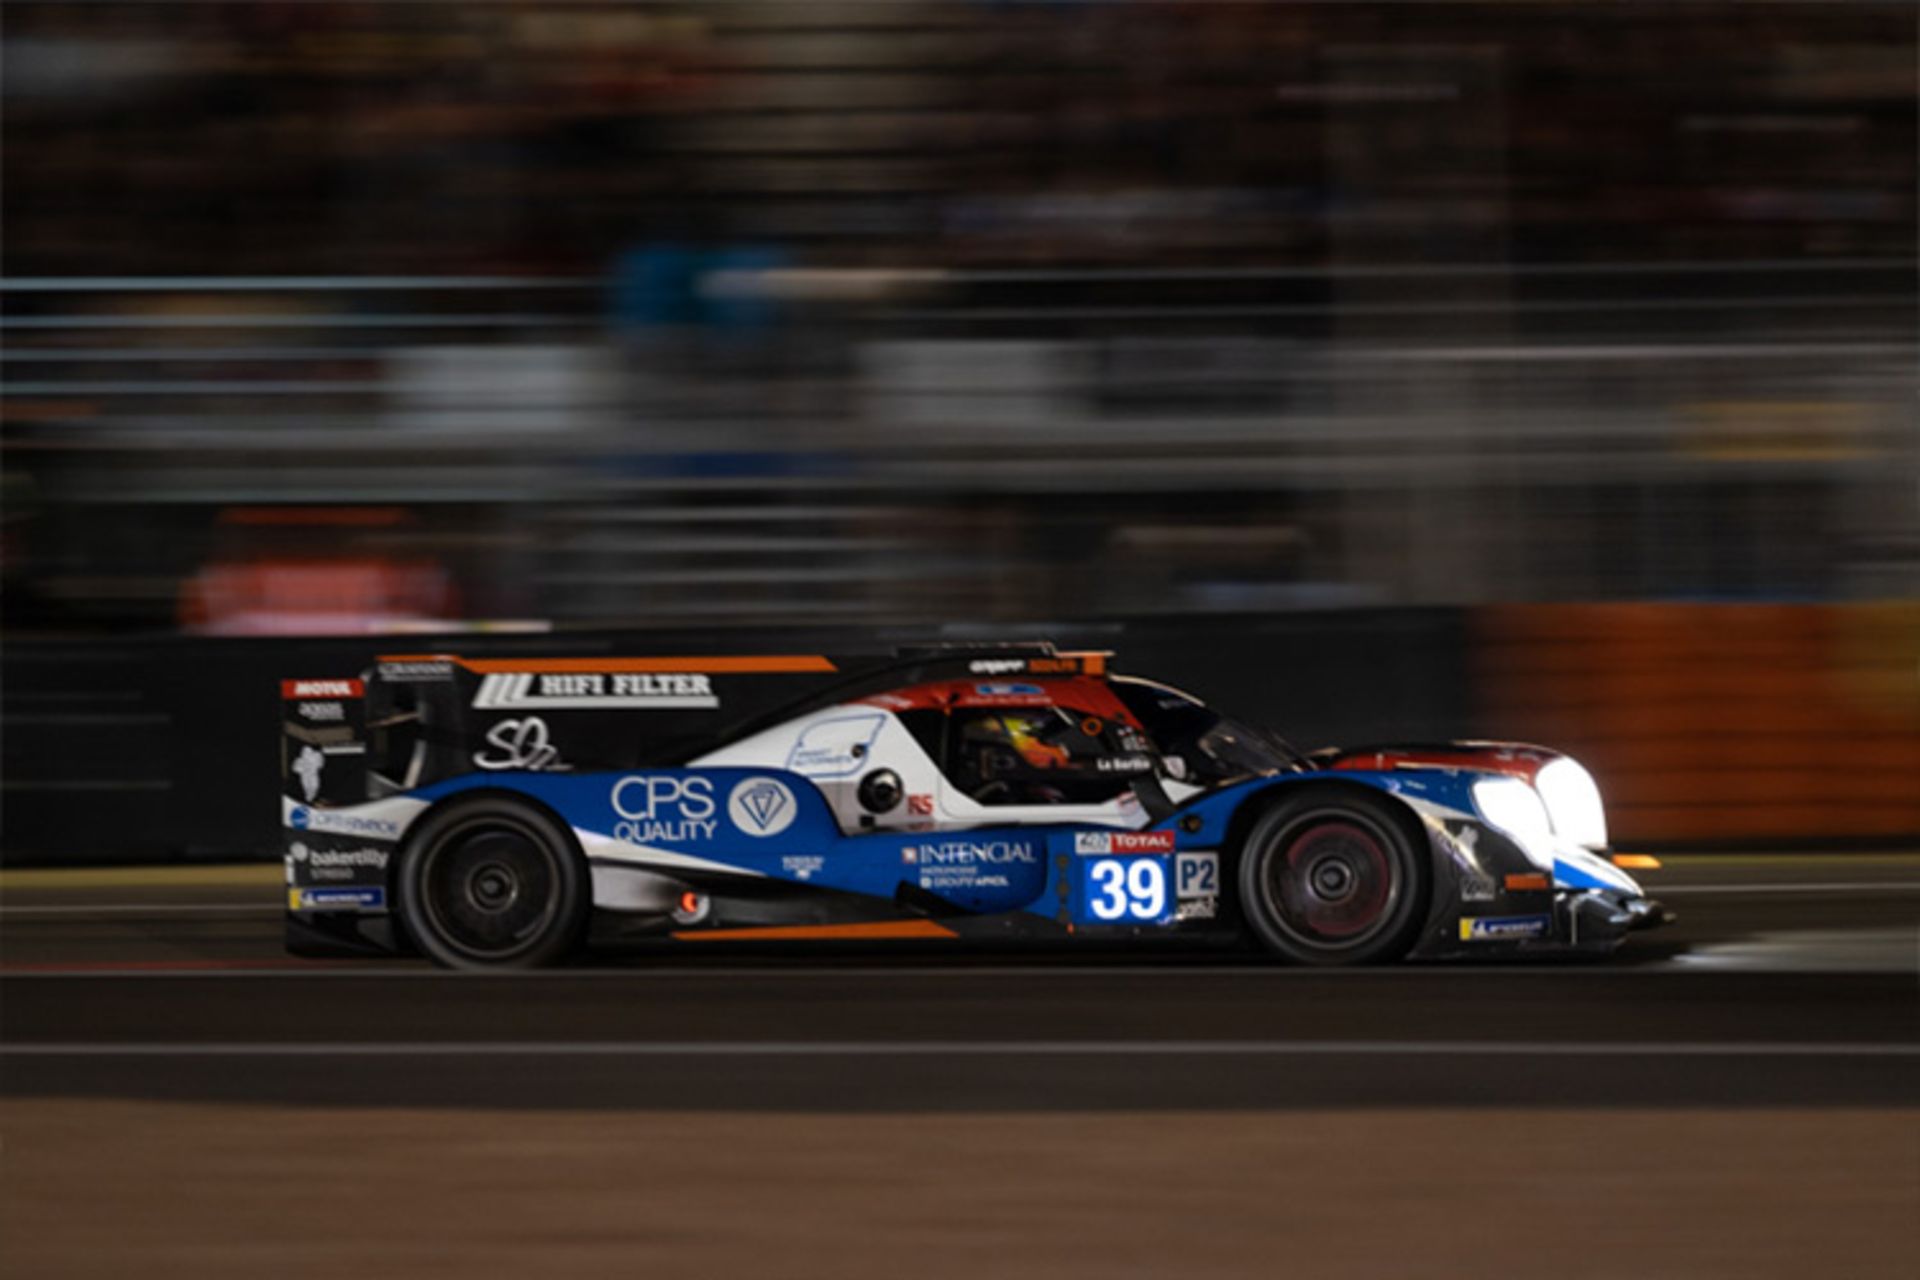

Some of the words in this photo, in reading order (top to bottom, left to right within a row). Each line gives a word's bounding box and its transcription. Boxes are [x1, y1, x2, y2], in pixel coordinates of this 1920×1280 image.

[541, 674, 603, 694] HIFI
[613, 674, 712, 695] FILTER
[611, 775, 715, 820] CPS
[613, 820, 718, 842] QUALITY
[1114, 834, 1171, 848] TOTAL
[919, 841, 1037, 864] INTENCIAL
[1180, 859, 1215, 891] P2
[1090, 857, 1166, 920] 39
